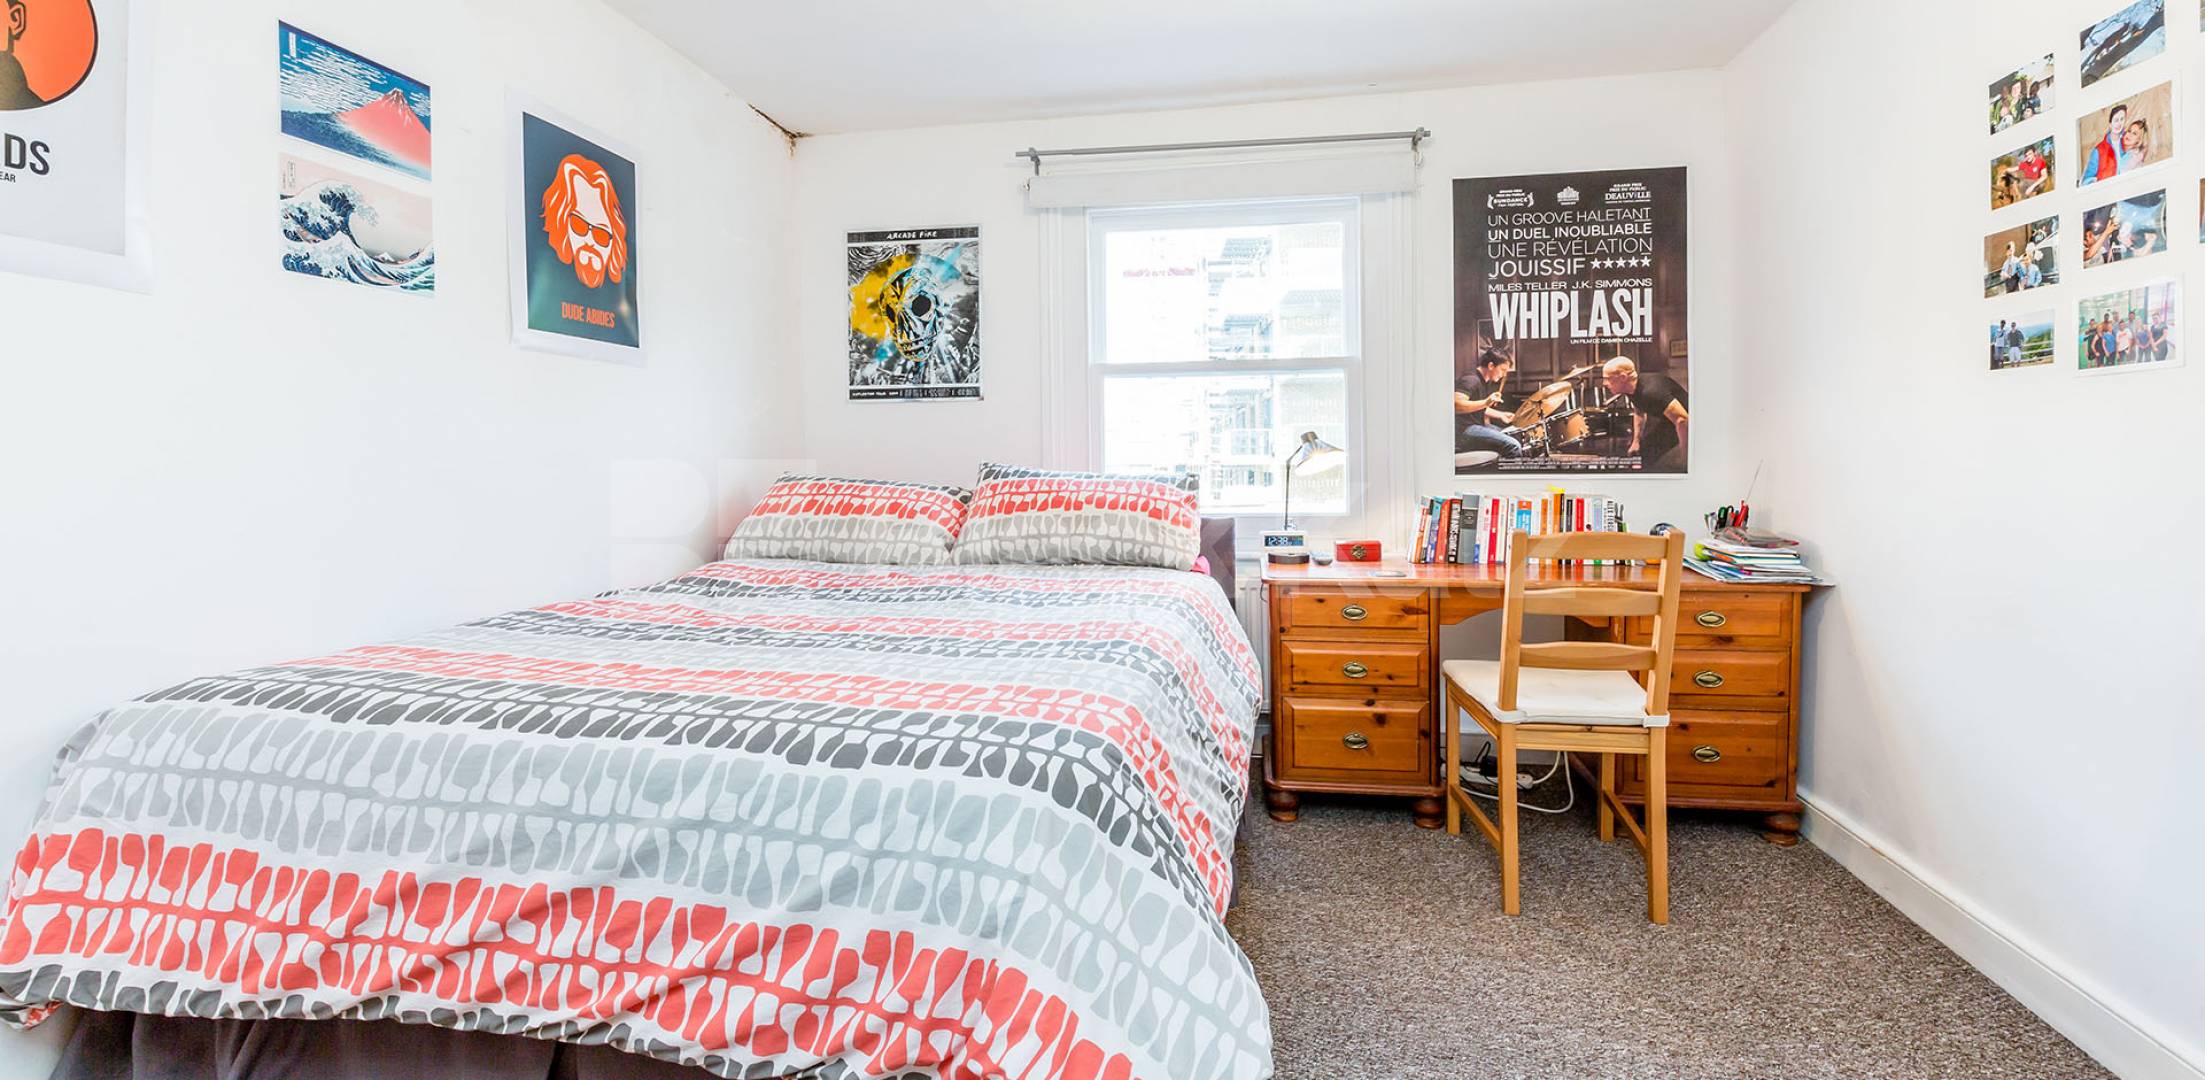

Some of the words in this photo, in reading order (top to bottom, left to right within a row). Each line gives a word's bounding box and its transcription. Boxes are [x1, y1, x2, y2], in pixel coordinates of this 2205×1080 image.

[1488, 213, 1508, 227] UN
[1512, 211, 1573, 225] GROOVE
[1577, 208, 1652, 222] HALETANT
[886, 231, 917, 240] ARCADE
[1488, 229, 1509, 242] UN
[1513, 227, 1549, 240] DUEL
[1554, 222, 1652, 237] INOUBLIABLE
[1488, 242, 1527, 259] UNE
[1533, 237, 1653, 257] RÉVÉLATION
[1488, 258, 1585, 279] JOUISSIF
[1488, 284, 1523, 292] MILES
[1524, 281, 1567, 291] TELLER
[1572, 280, 1592, 289] J.K.
[1595, 278, 1652, 287] SIMMONS
[561, 302, 584, 320] DUDE
[586, 307, 615, 328] ABIDES
[1489, 288, 1653, 340] WHIPLASH
